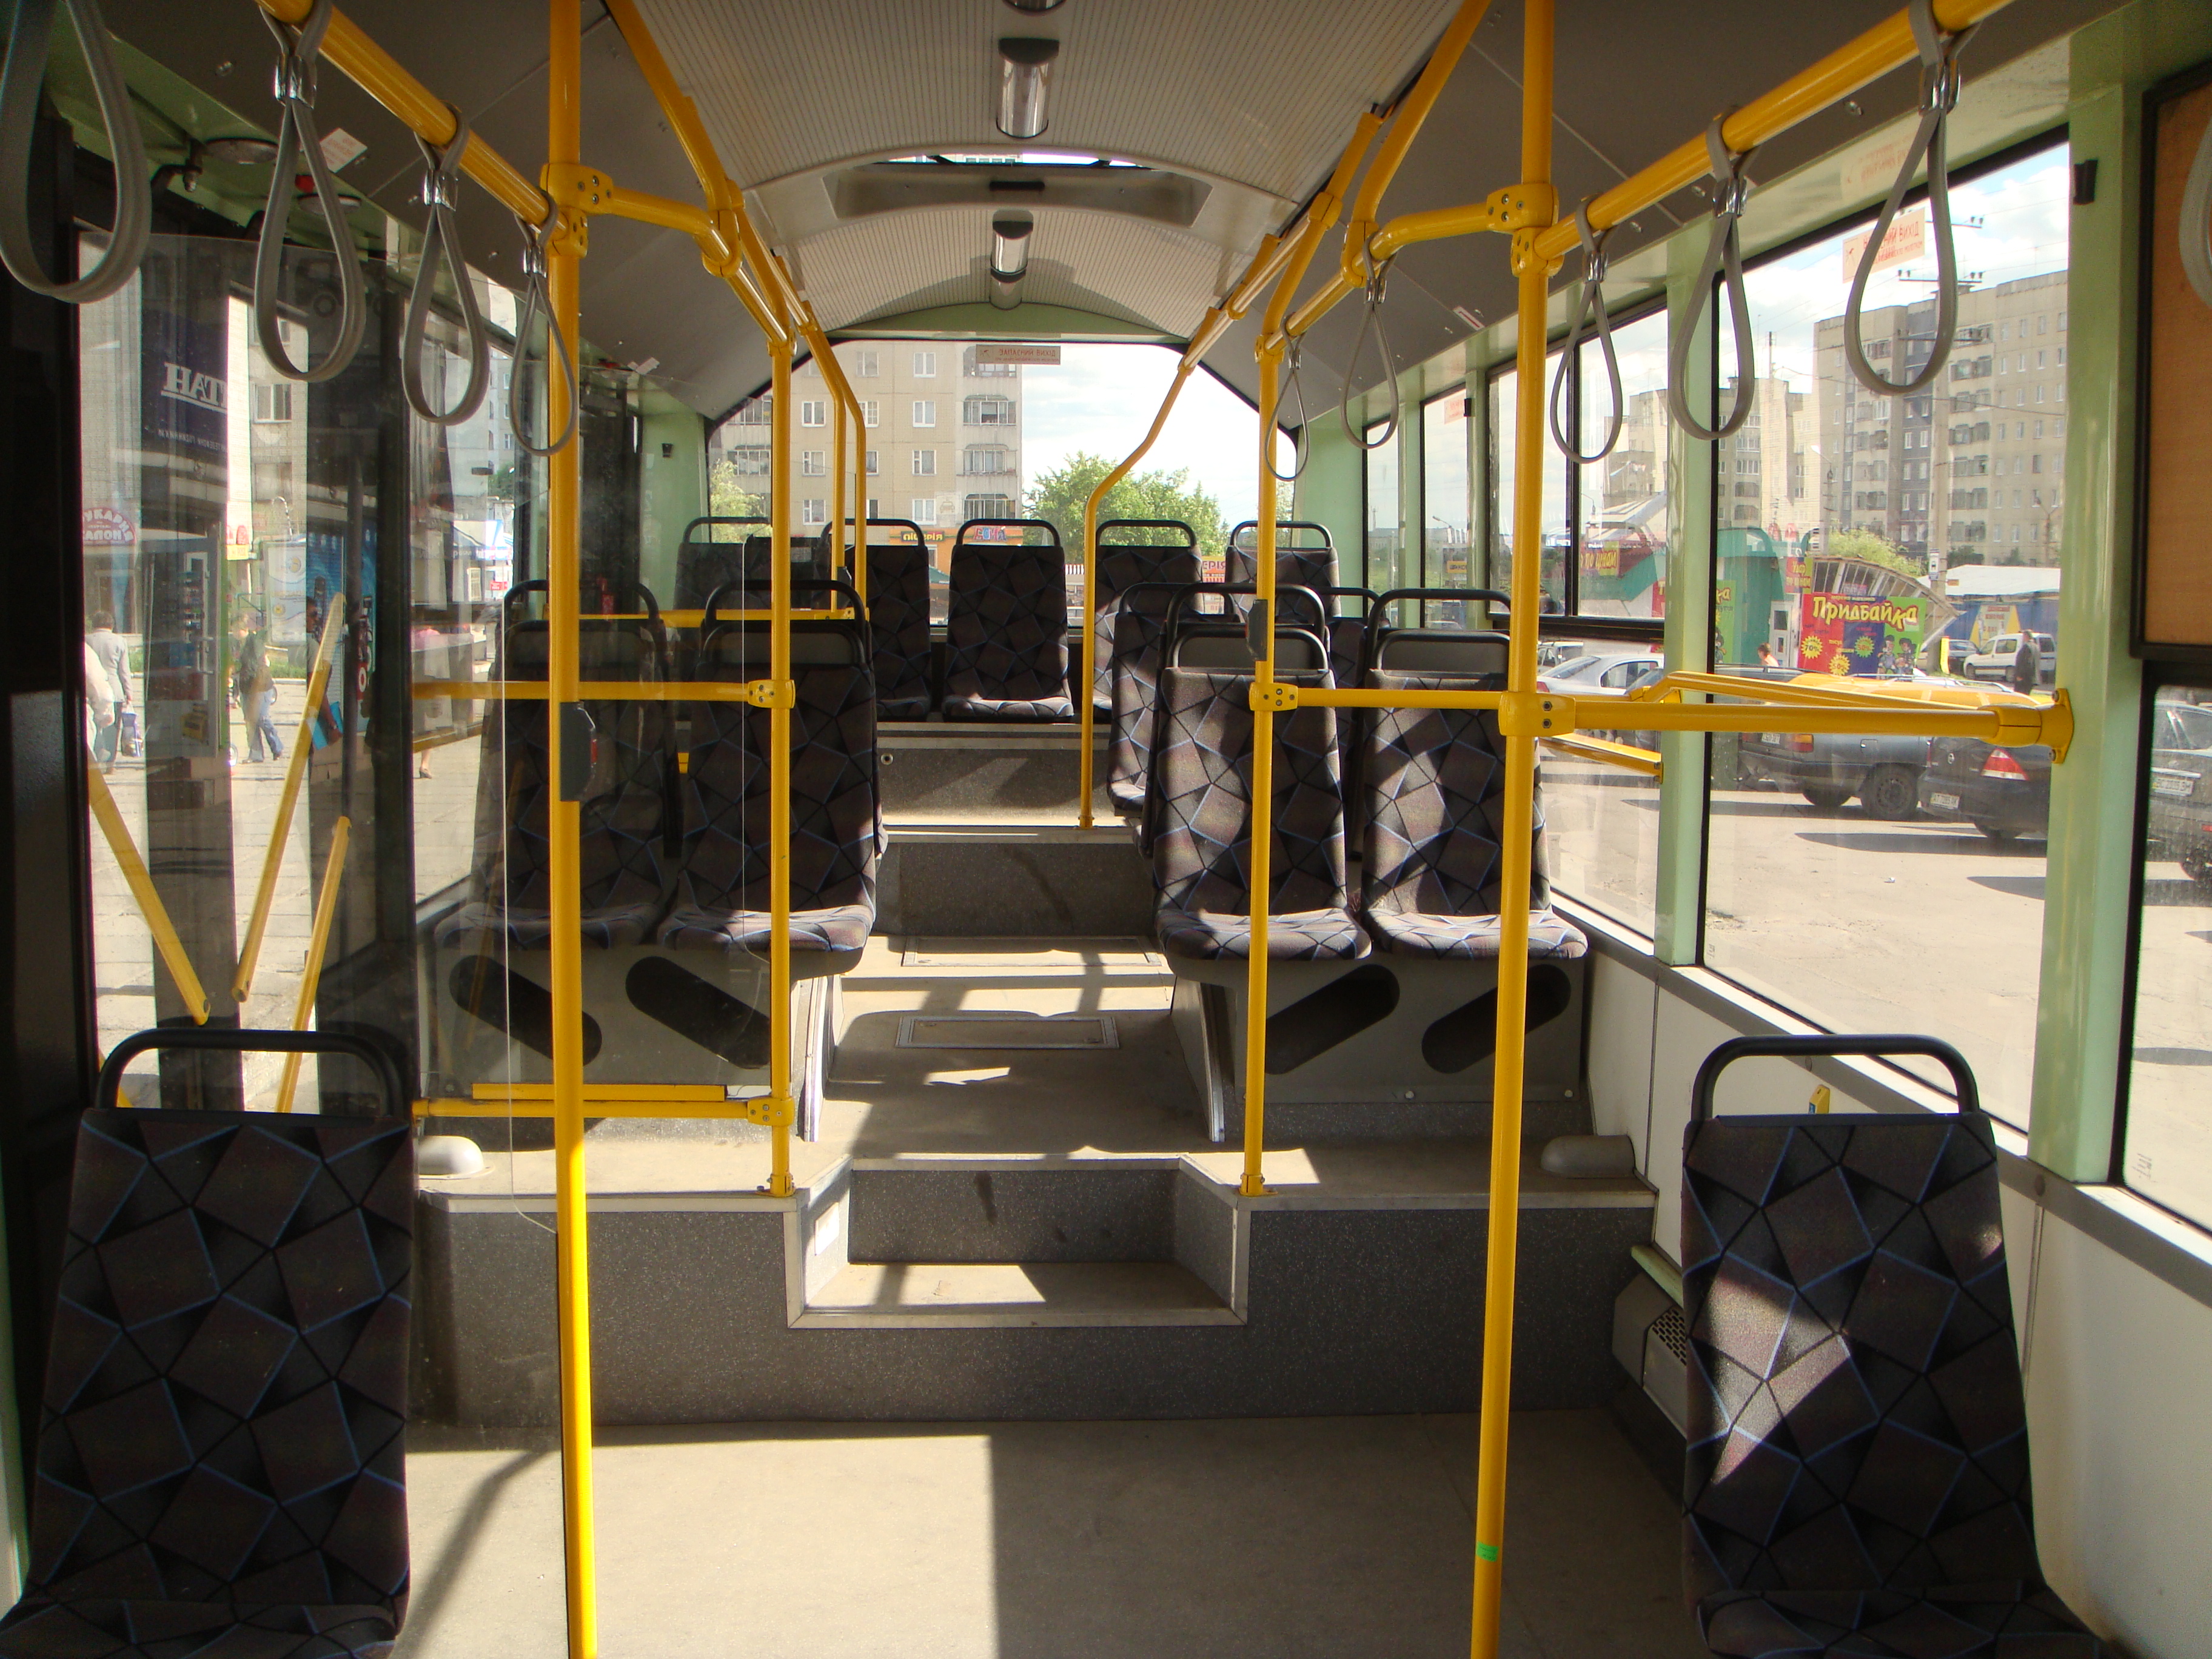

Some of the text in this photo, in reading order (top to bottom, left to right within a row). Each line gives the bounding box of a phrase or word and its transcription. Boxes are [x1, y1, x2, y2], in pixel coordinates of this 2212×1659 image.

[84, 509, 134, 542] УКАРНЯ
[84, 530, 122, 540] АЛОН
[1812, 595, 1919, 630] Придбайка
